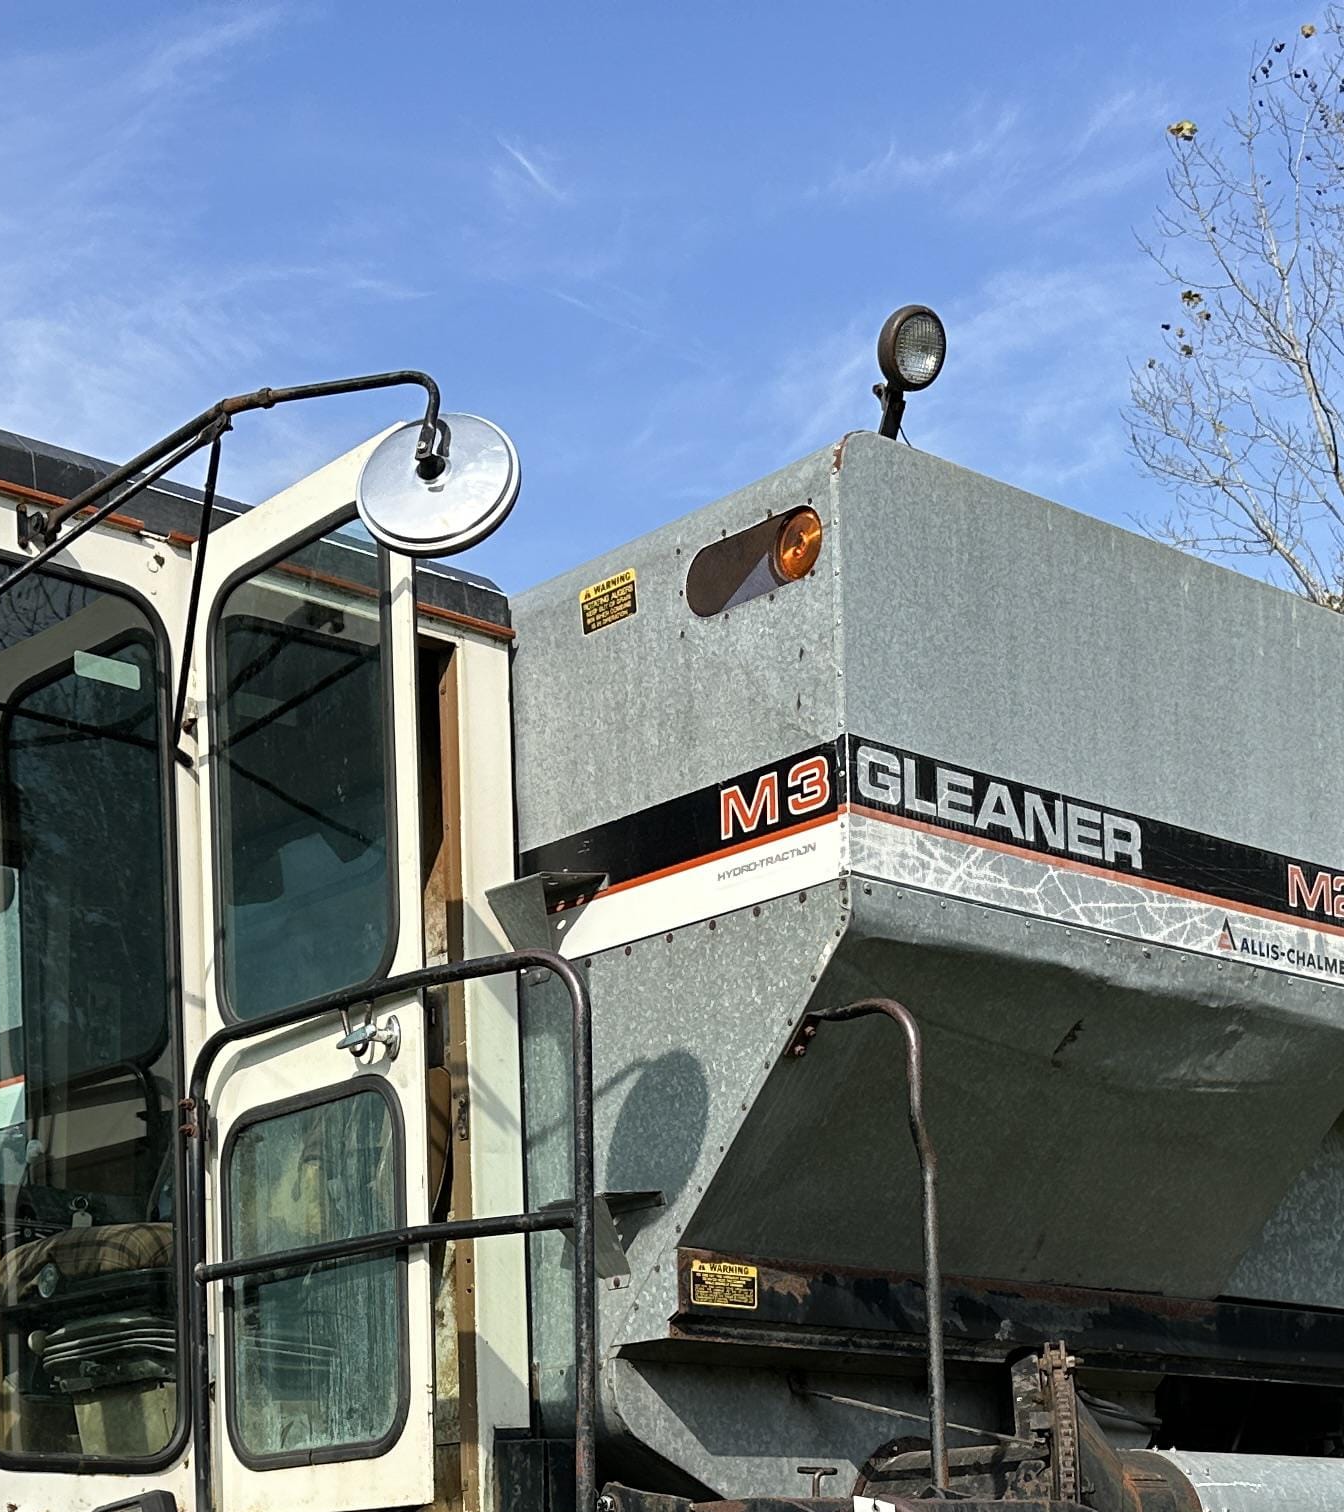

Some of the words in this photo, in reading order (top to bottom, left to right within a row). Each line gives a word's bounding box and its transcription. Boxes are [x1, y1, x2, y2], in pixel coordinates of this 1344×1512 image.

[593, 572, 631, 595] WARNING
[857, 745, 1143, 870] GLEANER
[709, 1263, 749, 1275] WARNING
